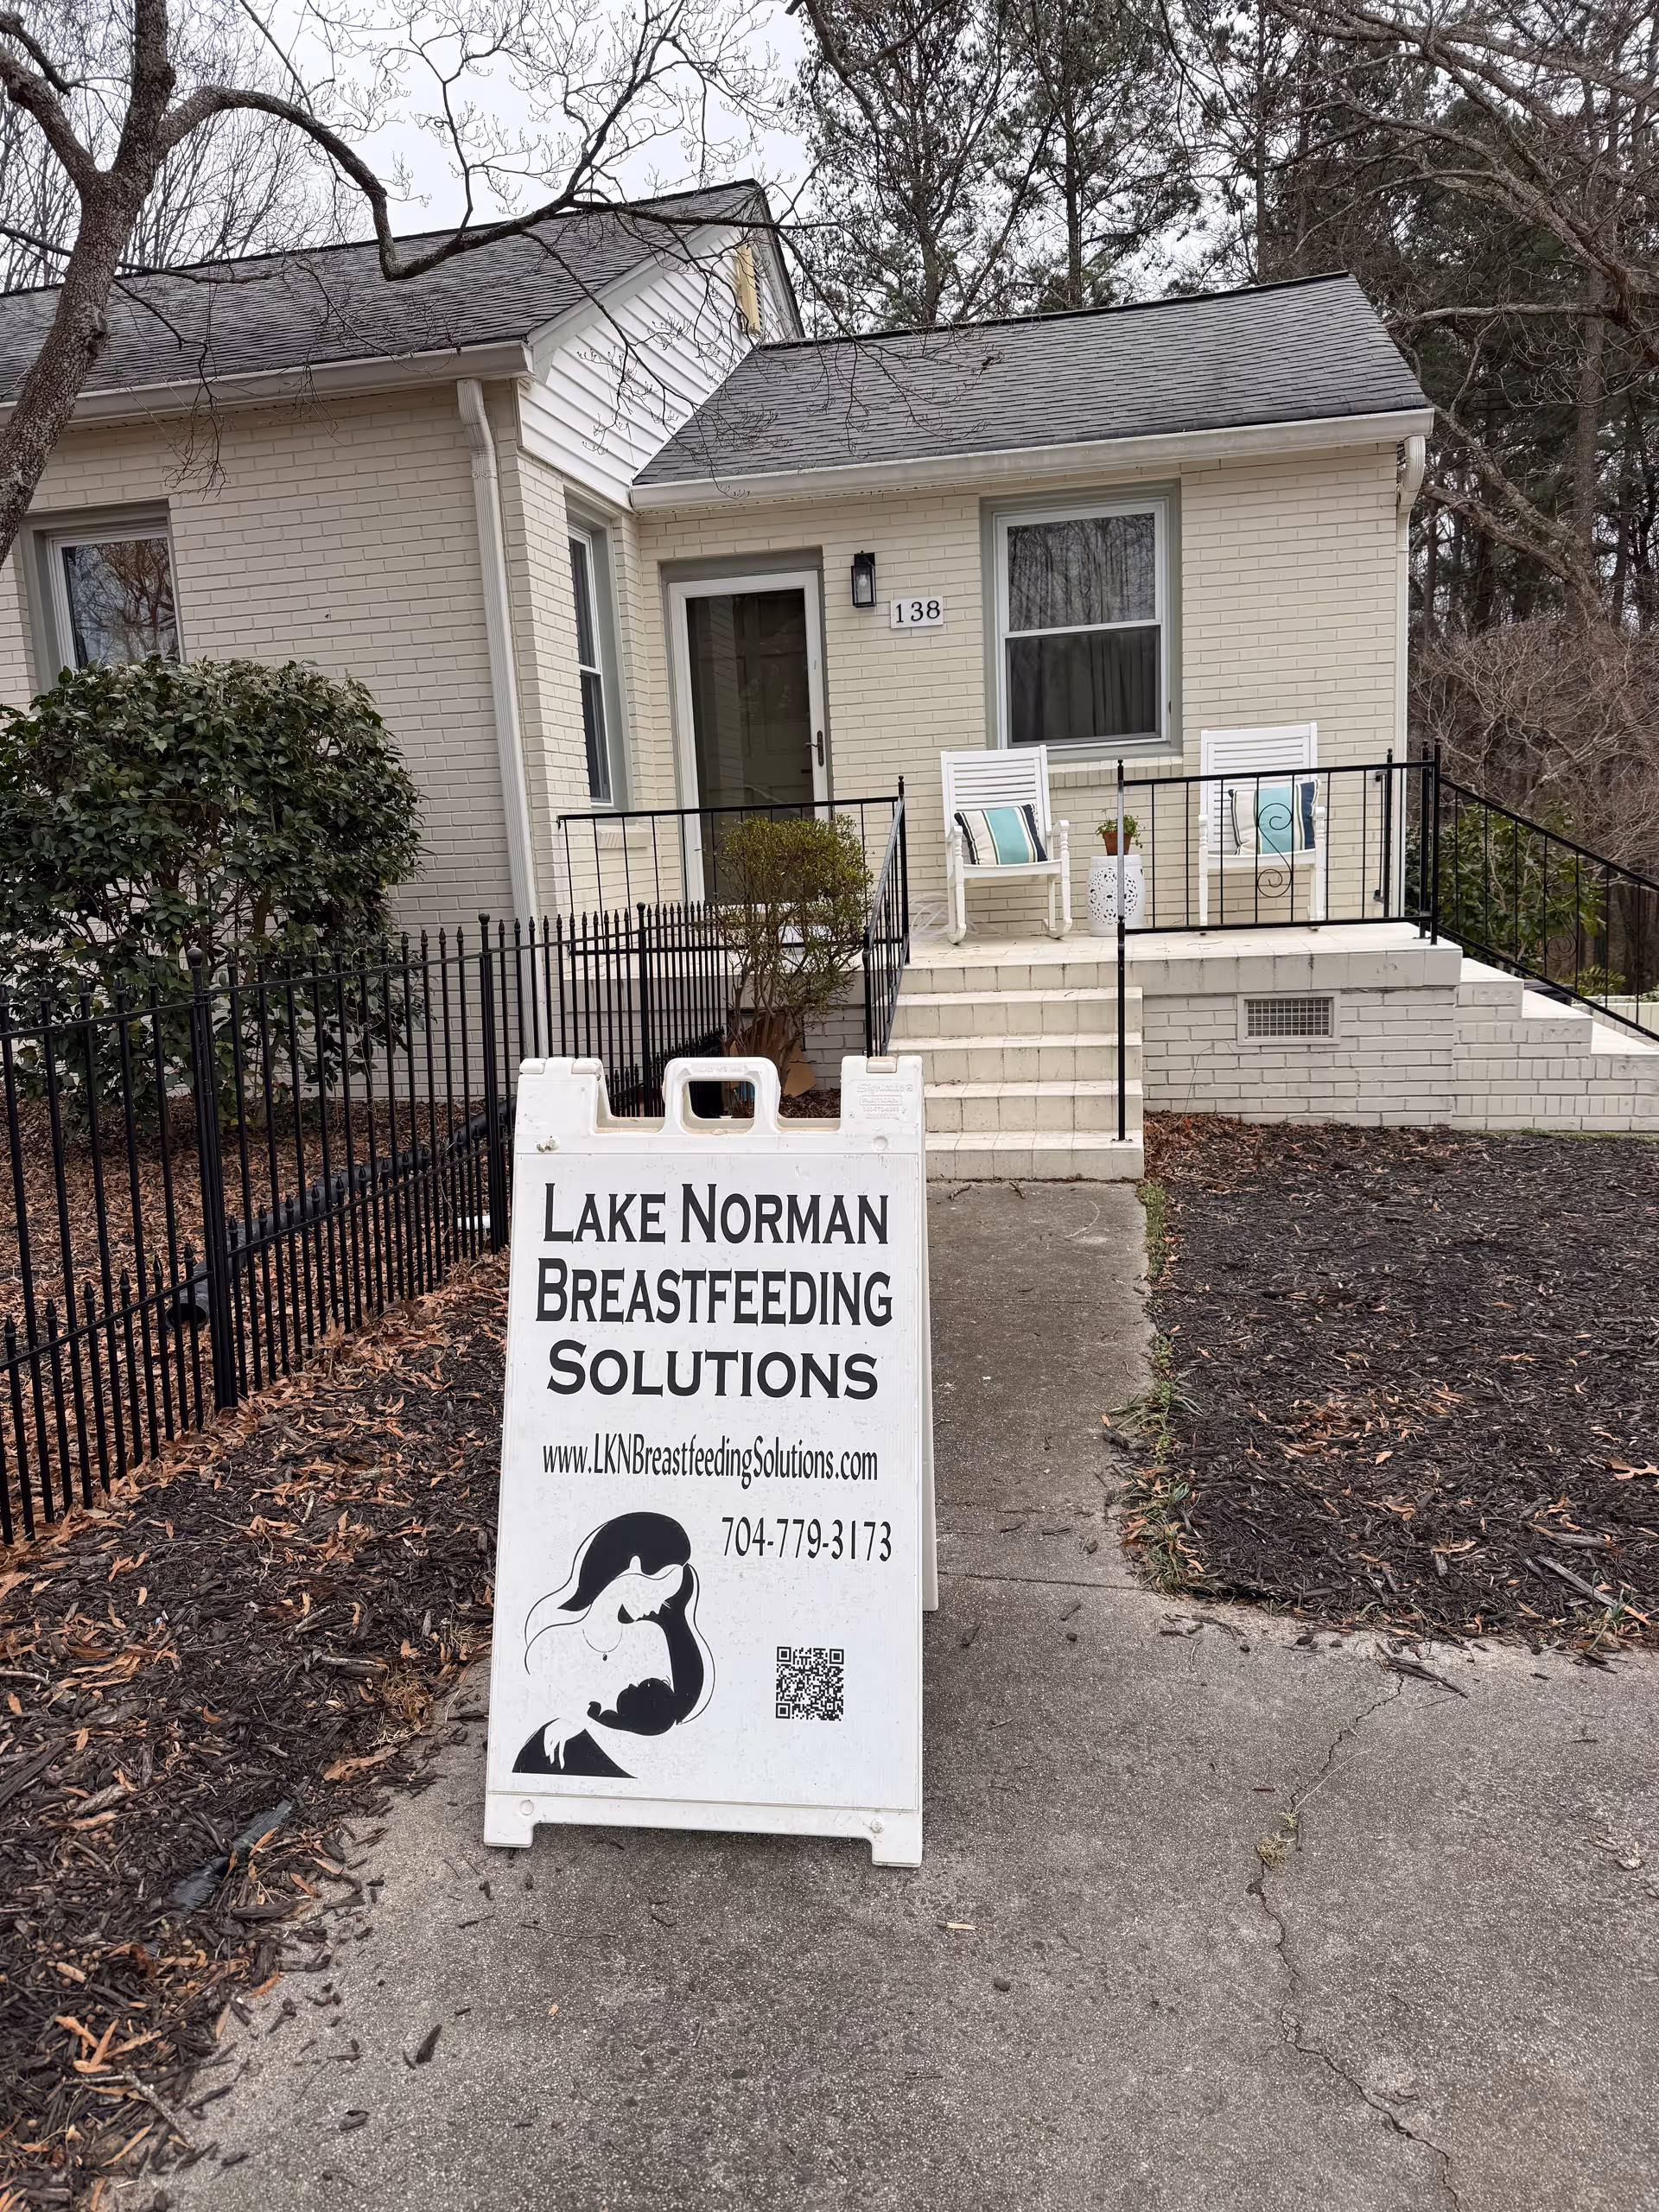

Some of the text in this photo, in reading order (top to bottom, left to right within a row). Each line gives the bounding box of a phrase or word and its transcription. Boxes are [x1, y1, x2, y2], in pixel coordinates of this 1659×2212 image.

[895, 600, 941, 623] 138
[543, 1182, 889, 1244] LAKE NORMAN
[535, 1257, 893, 1327] BREASTFEEDING
[546, 1339, 878, 1400] SOLUTIONS
[543, 1433, 878, 1489] www.LKNBreastfeedingSolutions.com
[721, 1516, 892, 1562] 704-779-3173
